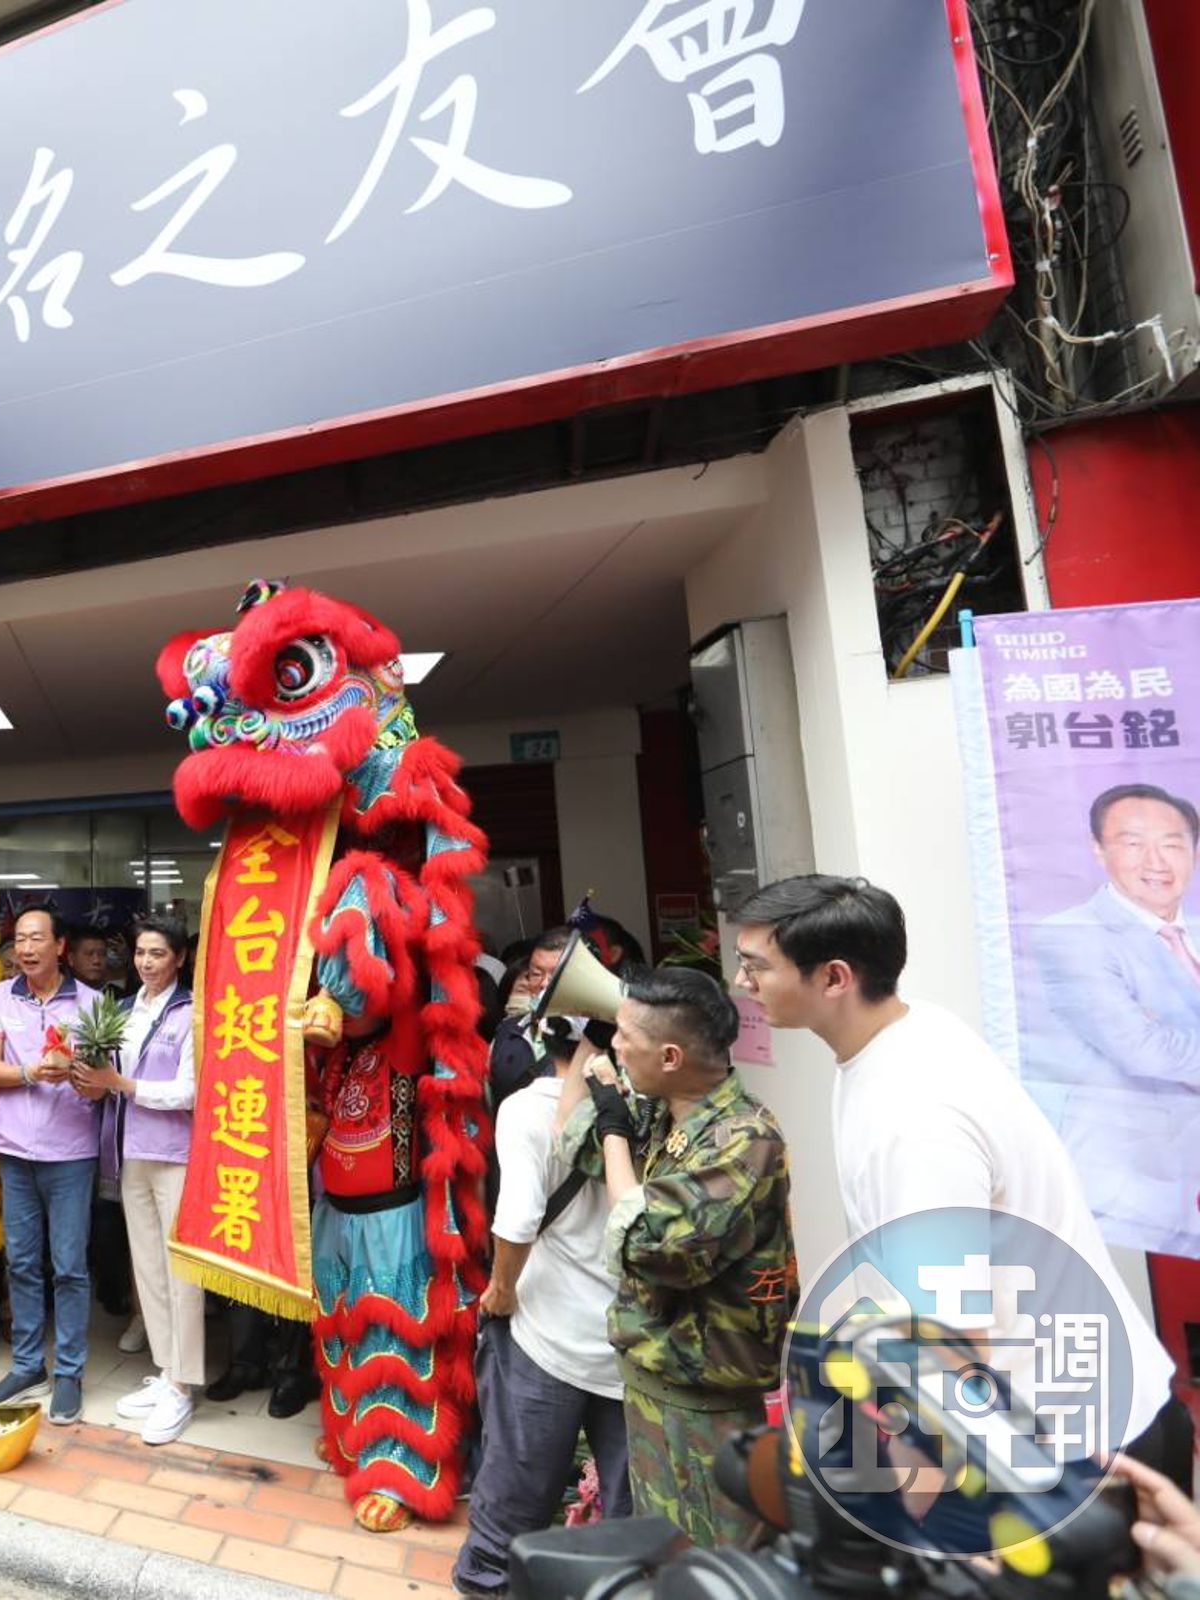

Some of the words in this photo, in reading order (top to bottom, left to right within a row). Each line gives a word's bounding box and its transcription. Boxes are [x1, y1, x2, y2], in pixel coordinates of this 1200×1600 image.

[1002, 645, 1088, 661] TIMING
[1003, 666, 1174, 704] 為國為民
[1004, 707, 1181, 750] 郭台銘
[210, 822, 300, 1253] 全台挺連署
